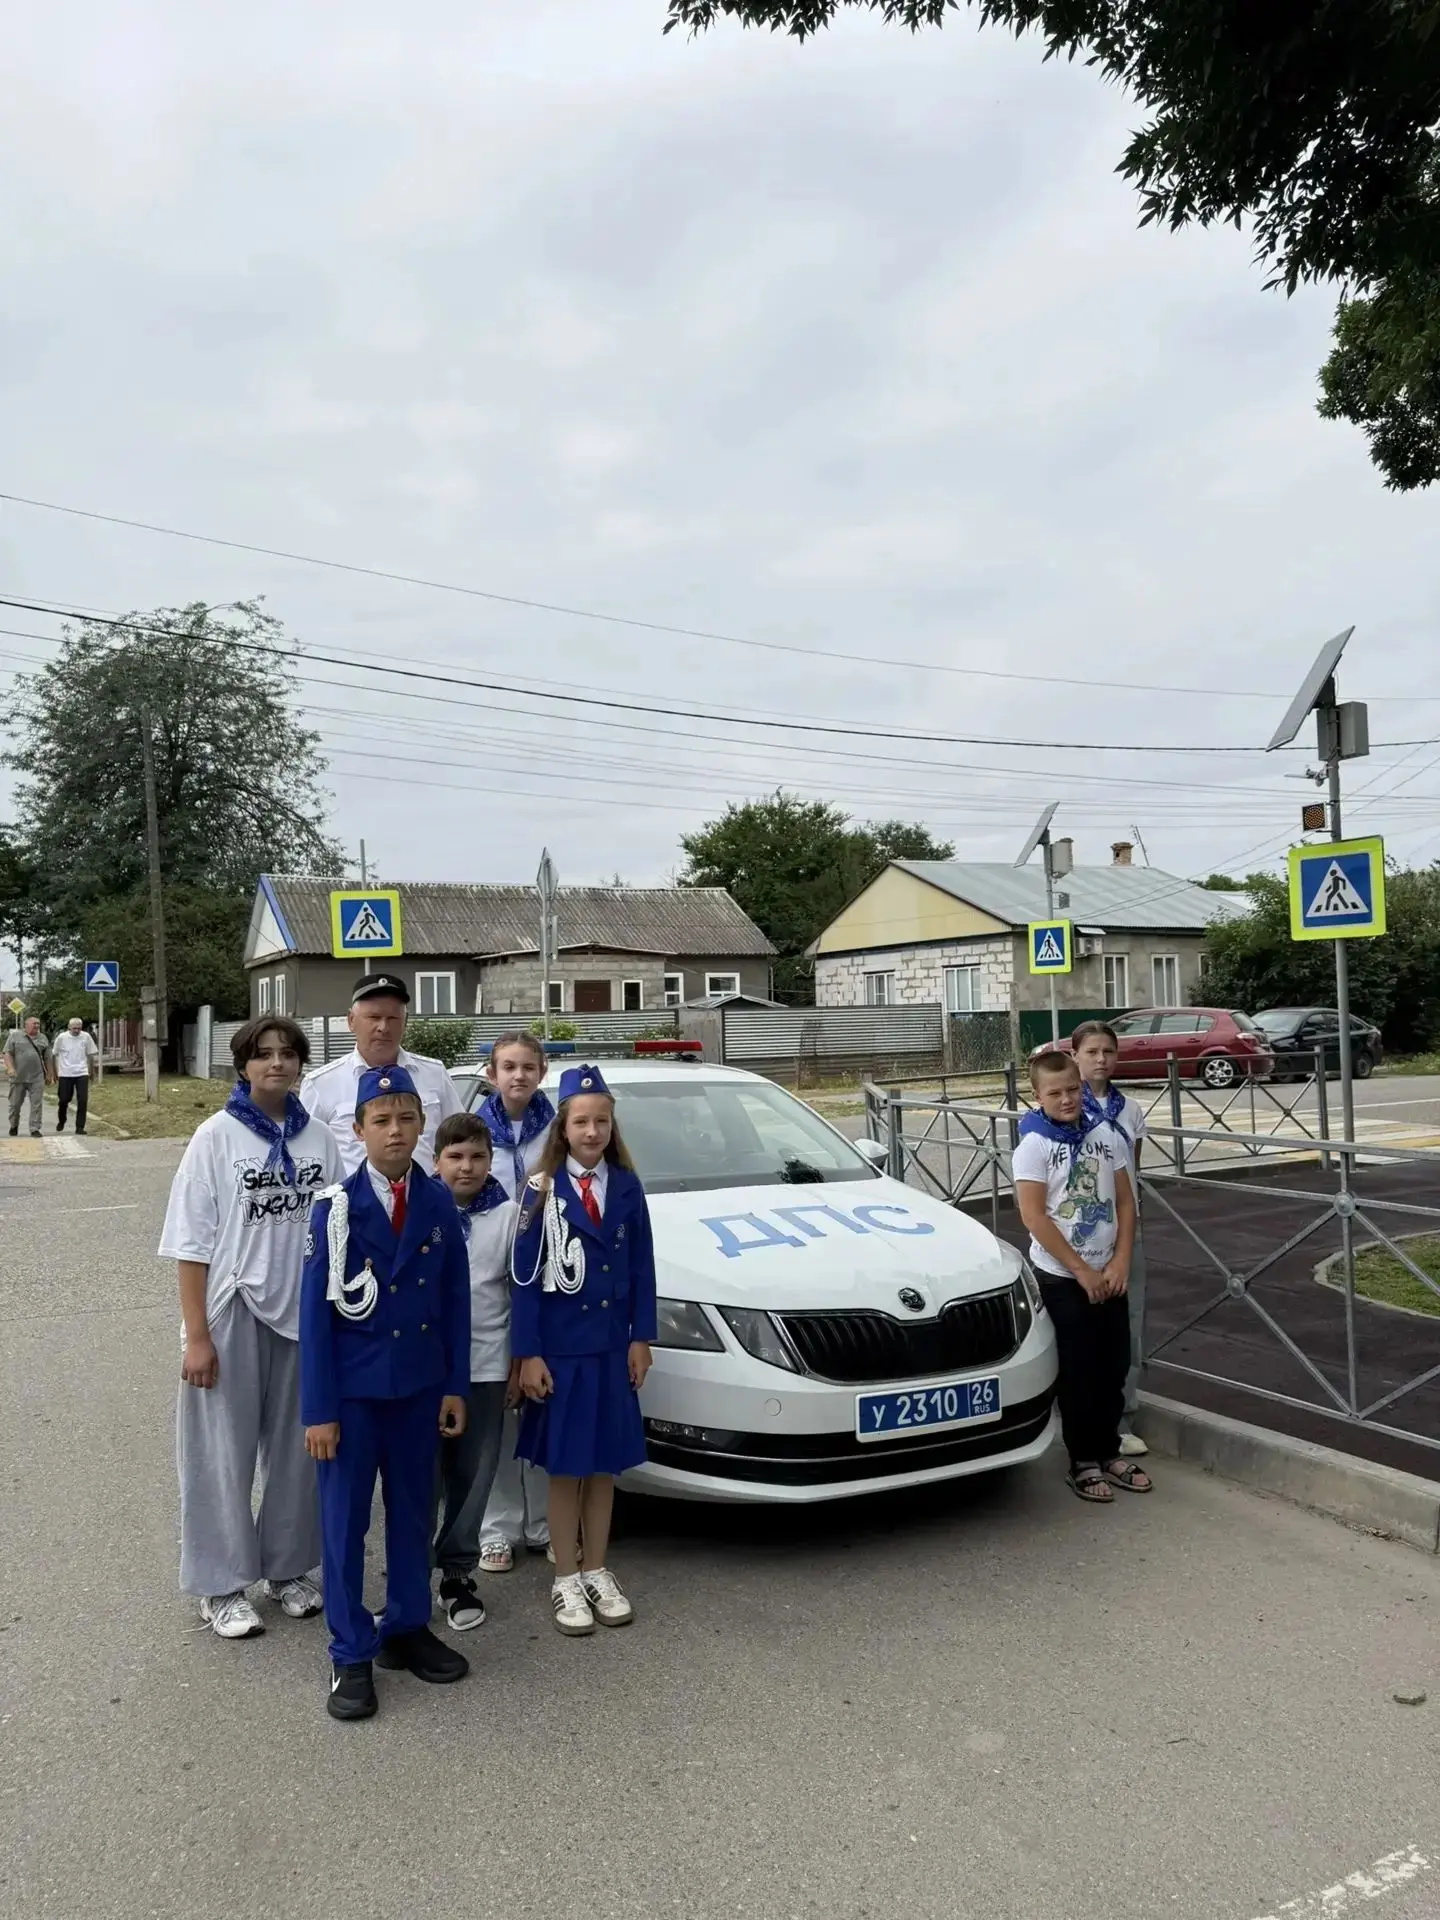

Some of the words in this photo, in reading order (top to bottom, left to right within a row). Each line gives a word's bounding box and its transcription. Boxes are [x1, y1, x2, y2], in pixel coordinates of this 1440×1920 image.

[699, 1205, 935, 1258] ДПС
[896, 1388, 958, 1425] 2310
[971, 1381, 994, 1405] 26
[974, 1403, 991, 1414] RUS
